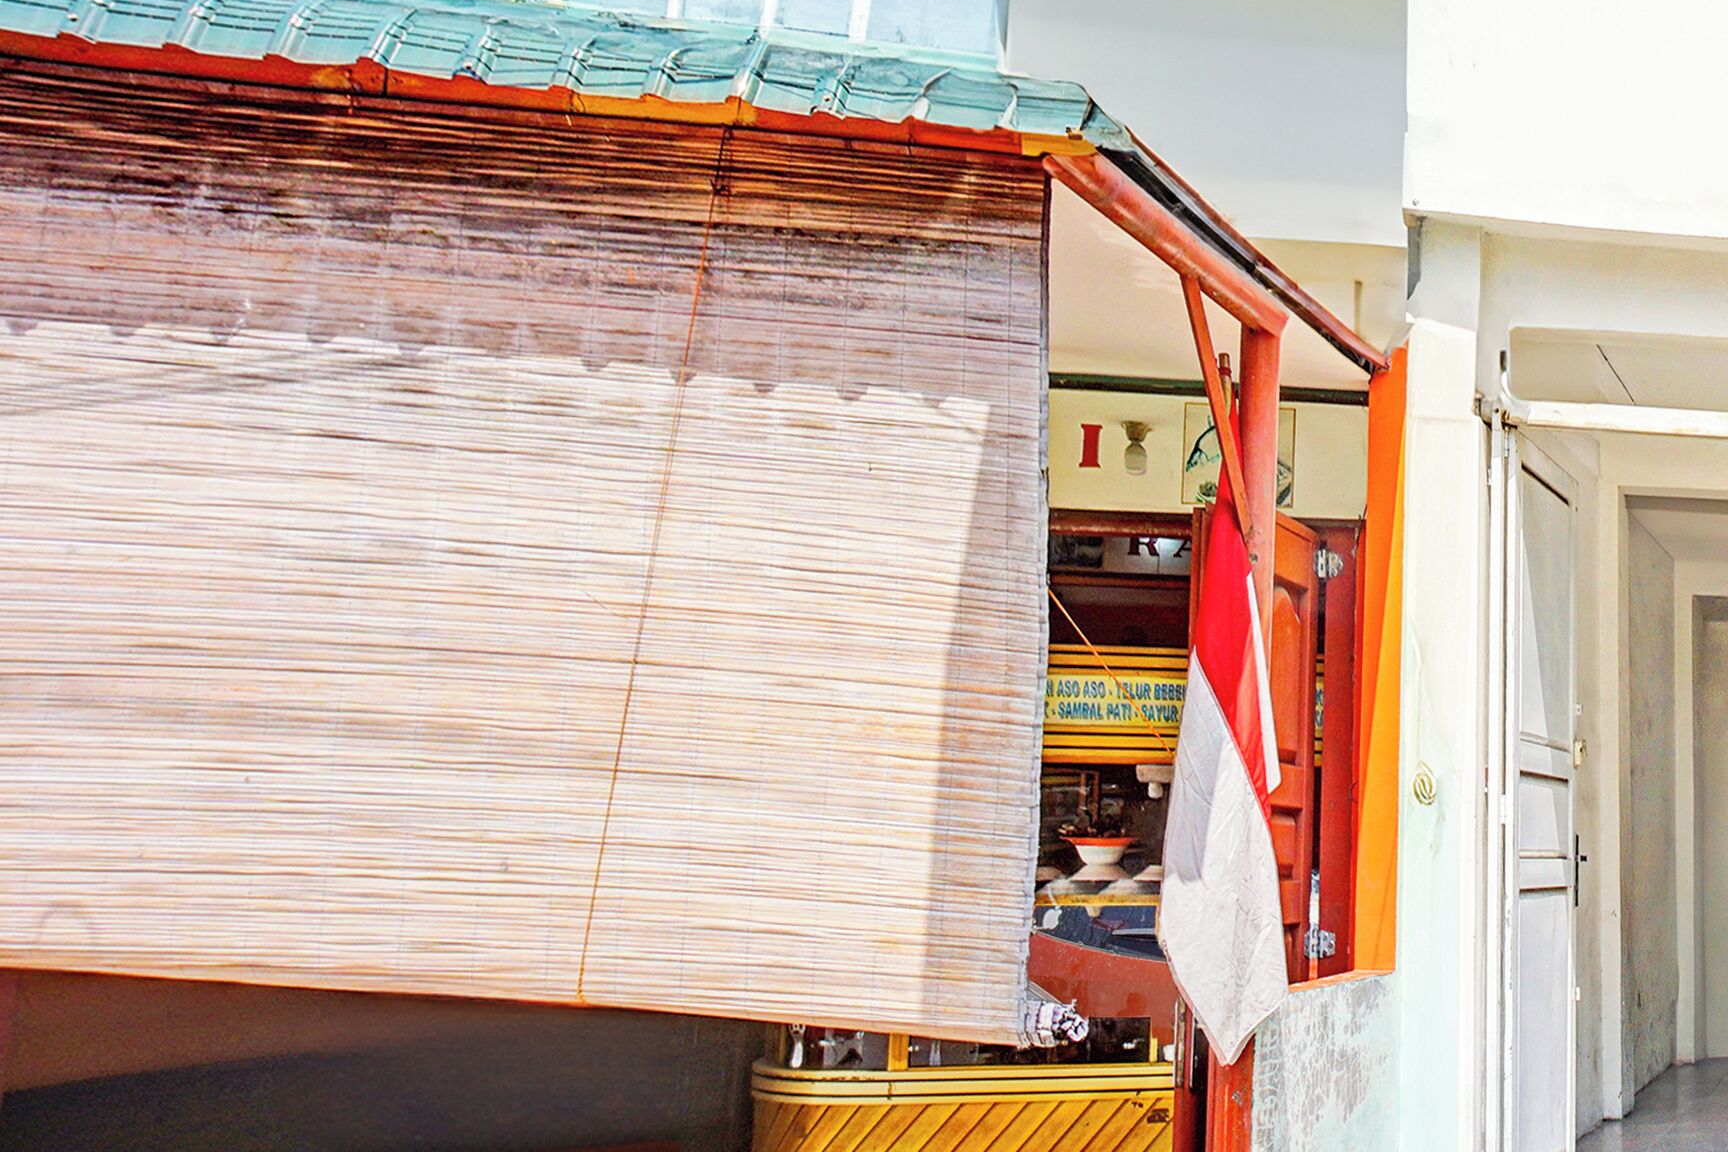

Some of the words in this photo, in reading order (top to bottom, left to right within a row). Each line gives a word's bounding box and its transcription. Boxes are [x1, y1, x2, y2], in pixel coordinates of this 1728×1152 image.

[1057, 679, 1080, 698] ASO
[1083, 680, 1106, 699] ASO
[1058, 701, 1103, 720] SAMBAL
[1141, 704, 1178, 722] SAYUR
